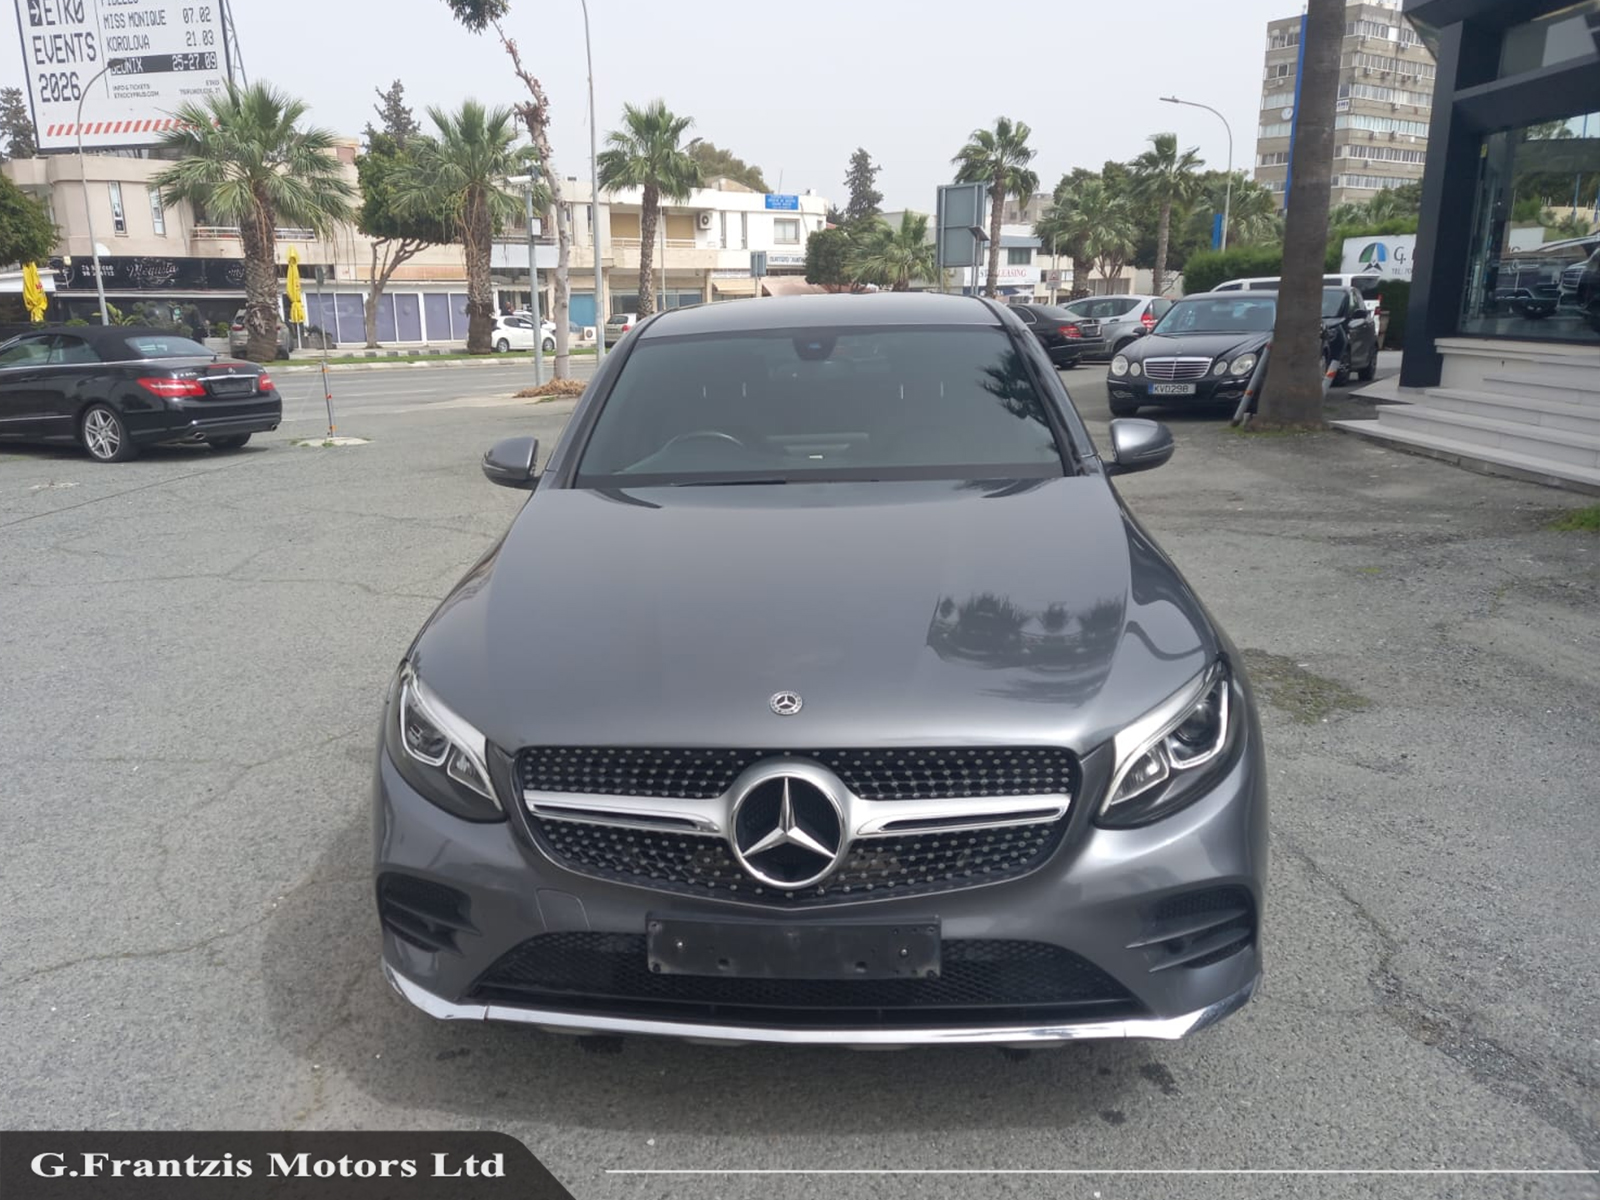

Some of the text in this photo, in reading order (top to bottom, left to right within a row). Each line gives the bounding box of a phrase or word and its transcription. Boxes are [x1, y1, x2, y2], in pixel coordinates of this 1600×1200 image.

[103, 10, 167, 30] MISS MONIQUE
[183, 6, 211, 24] 07.02
[106, 34, 150, 52] KOROLOVA
[186, 29, 214, 46] 21.03
[32, 31, 96, 65] EVENTS
[172, 52, 217, 71] 25-27.09
[39, 71, 81, 102] 2026
